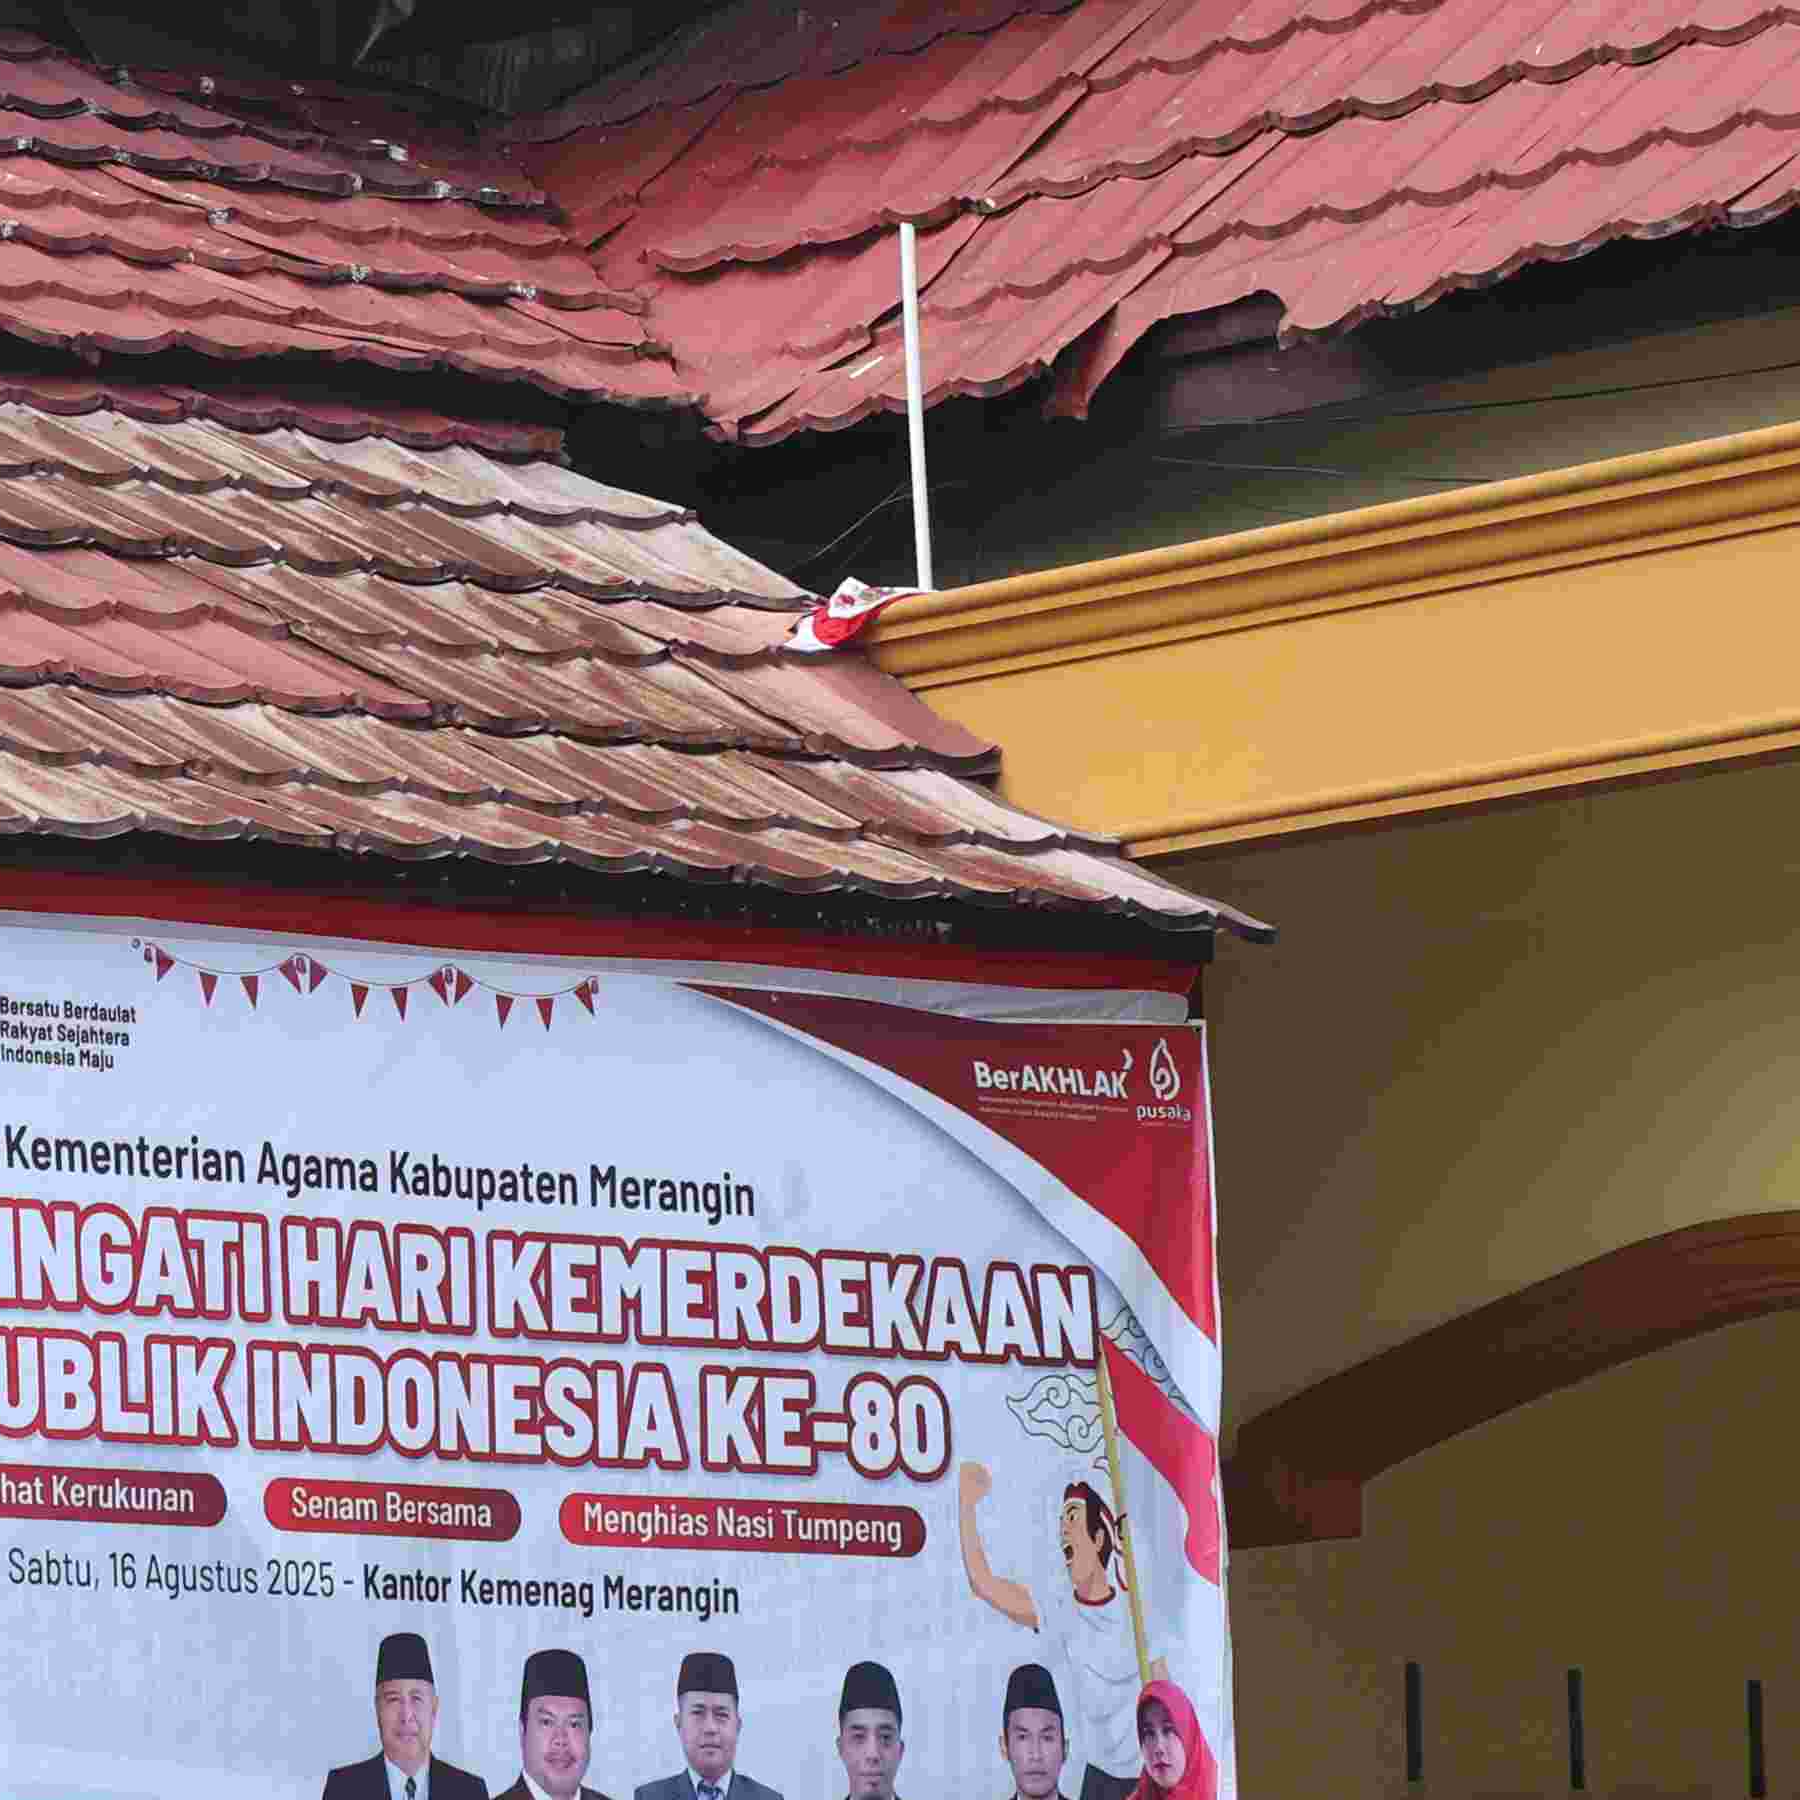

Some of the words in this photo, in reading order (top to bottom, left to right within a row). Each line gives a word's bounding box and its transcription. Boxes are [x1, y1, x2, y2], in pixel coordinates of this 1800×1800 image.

[0, 996, 60, 1018] Bersatu
[63, 1000, 137, 1024] Berdaulat
[0, 1021, 52, 1043] Rakyat
[56, 1023, 131, 1047] Sejahtera
[0, 1044, 76, 1067] Indonesia
[78, 1049, 115, 1072] Maju
[973, 1060, 1129, 1099] BerAKHLAK
[1136, 1104, 1192, 1122] pusaka
[3, 1122, 246, 1184] Kementerian
[256, 1140, 379, 1199] Agama
[390, 1149, 579, 1211] Kabupaten
[589, 1162, 756, 1226] Merangin
[280, 1215, 474, 1336] HARI
[487, 1229, 1098, 1368] KEMERDEKAAN
[248, 1340, 688, 1473] INDONESIA
[700, 1364, 951, 1483] KE-80
[51, 1475, 196, 1514] Kerukunan
[291, 1487, 378, 1523] Senam
[385, 1493, 493, 1528] Bersama
[583, 1502, 710, 1540] Menghias
[717, 1507, 776, 1540] Nasi
[782, 1509, 903, 1552] Tumpeng
[6, 1547, 101, 1592] Sabtu,
[107, 1550, 138, 1589] 16
[144, 1552, 259, 1599] Agustus
[266, 1559, 336, 1598] 2025
[362, 1563, 452, 1604] Kantor
[459, 1568, 595, 1618] Kemenag
[601, 1575, 741, 1622] Merangin
